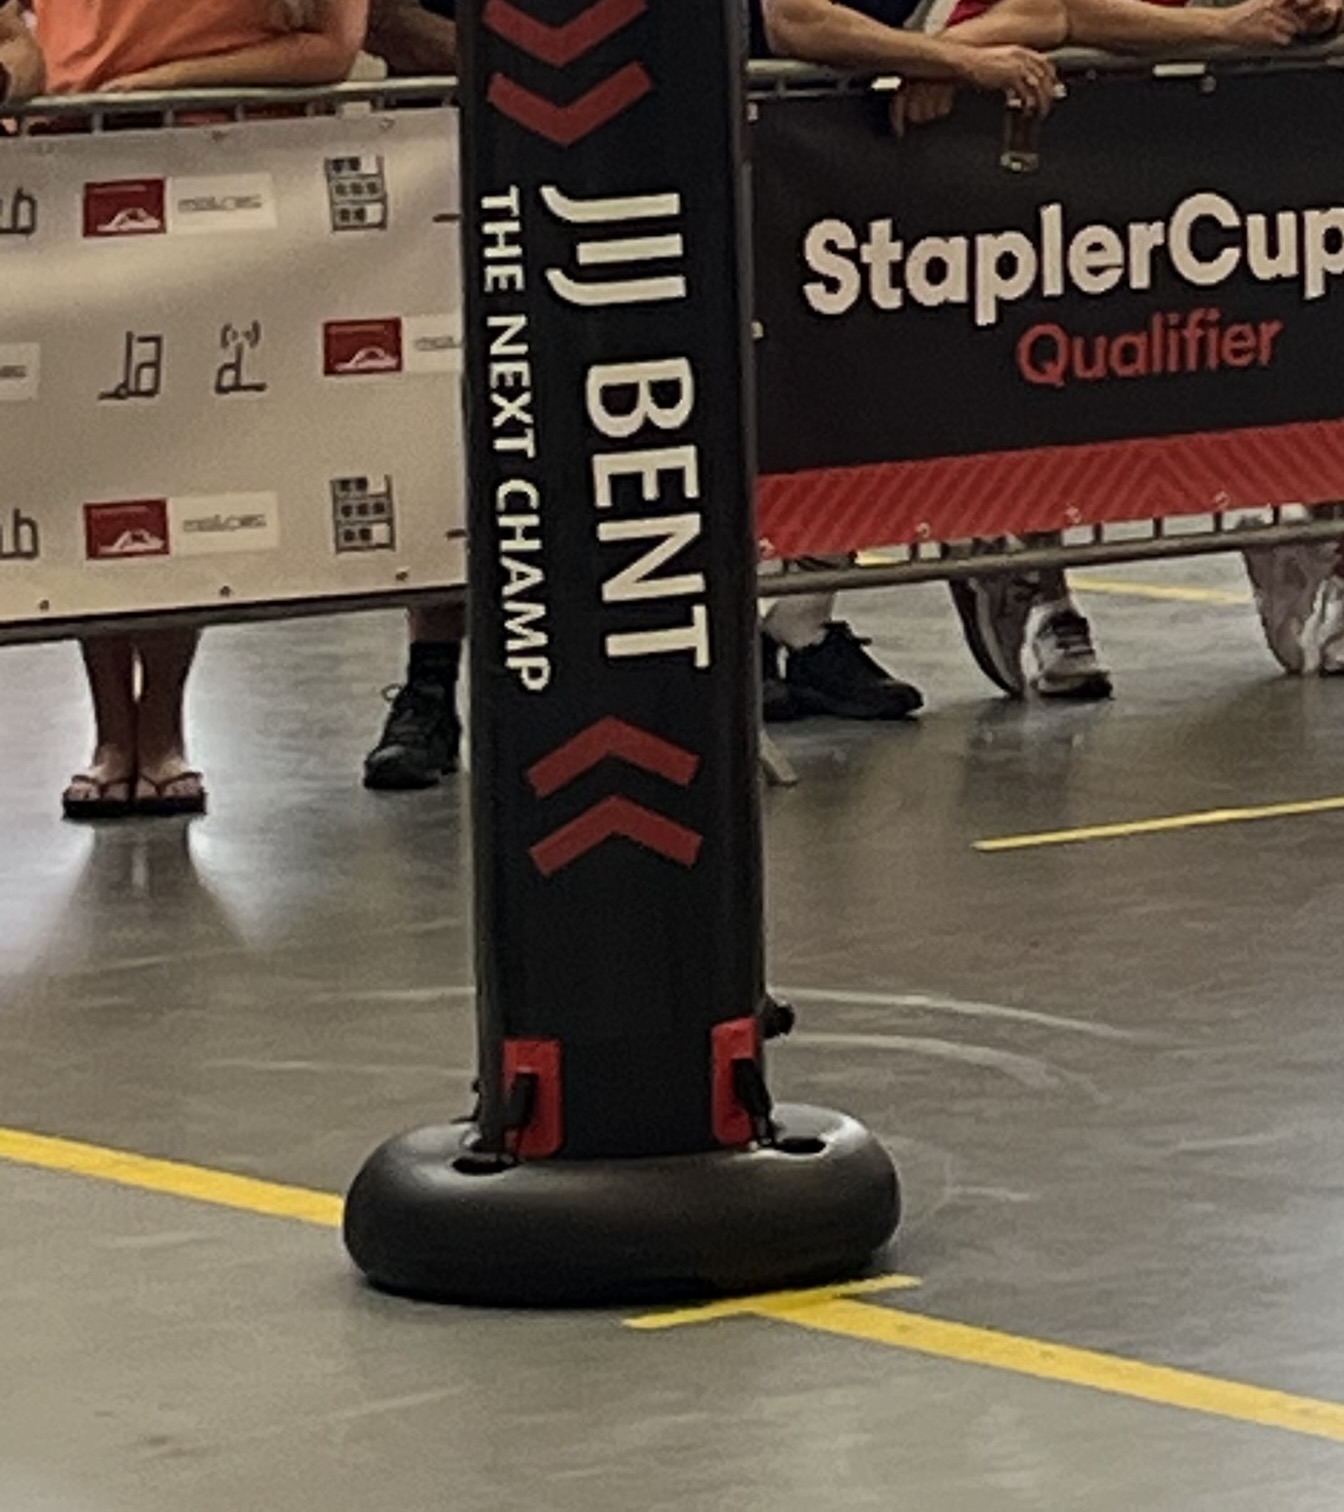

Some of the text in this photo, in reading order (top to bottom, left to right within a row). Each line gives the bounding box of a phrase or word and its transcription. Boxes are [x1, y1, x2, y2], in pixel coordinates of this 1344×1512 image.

[479, 184, 551, 692] THE NEXT CHAMP
[541, 186, 711, 669] JIJ BENT
[1016, 308, 1284, 387] Qualifier
